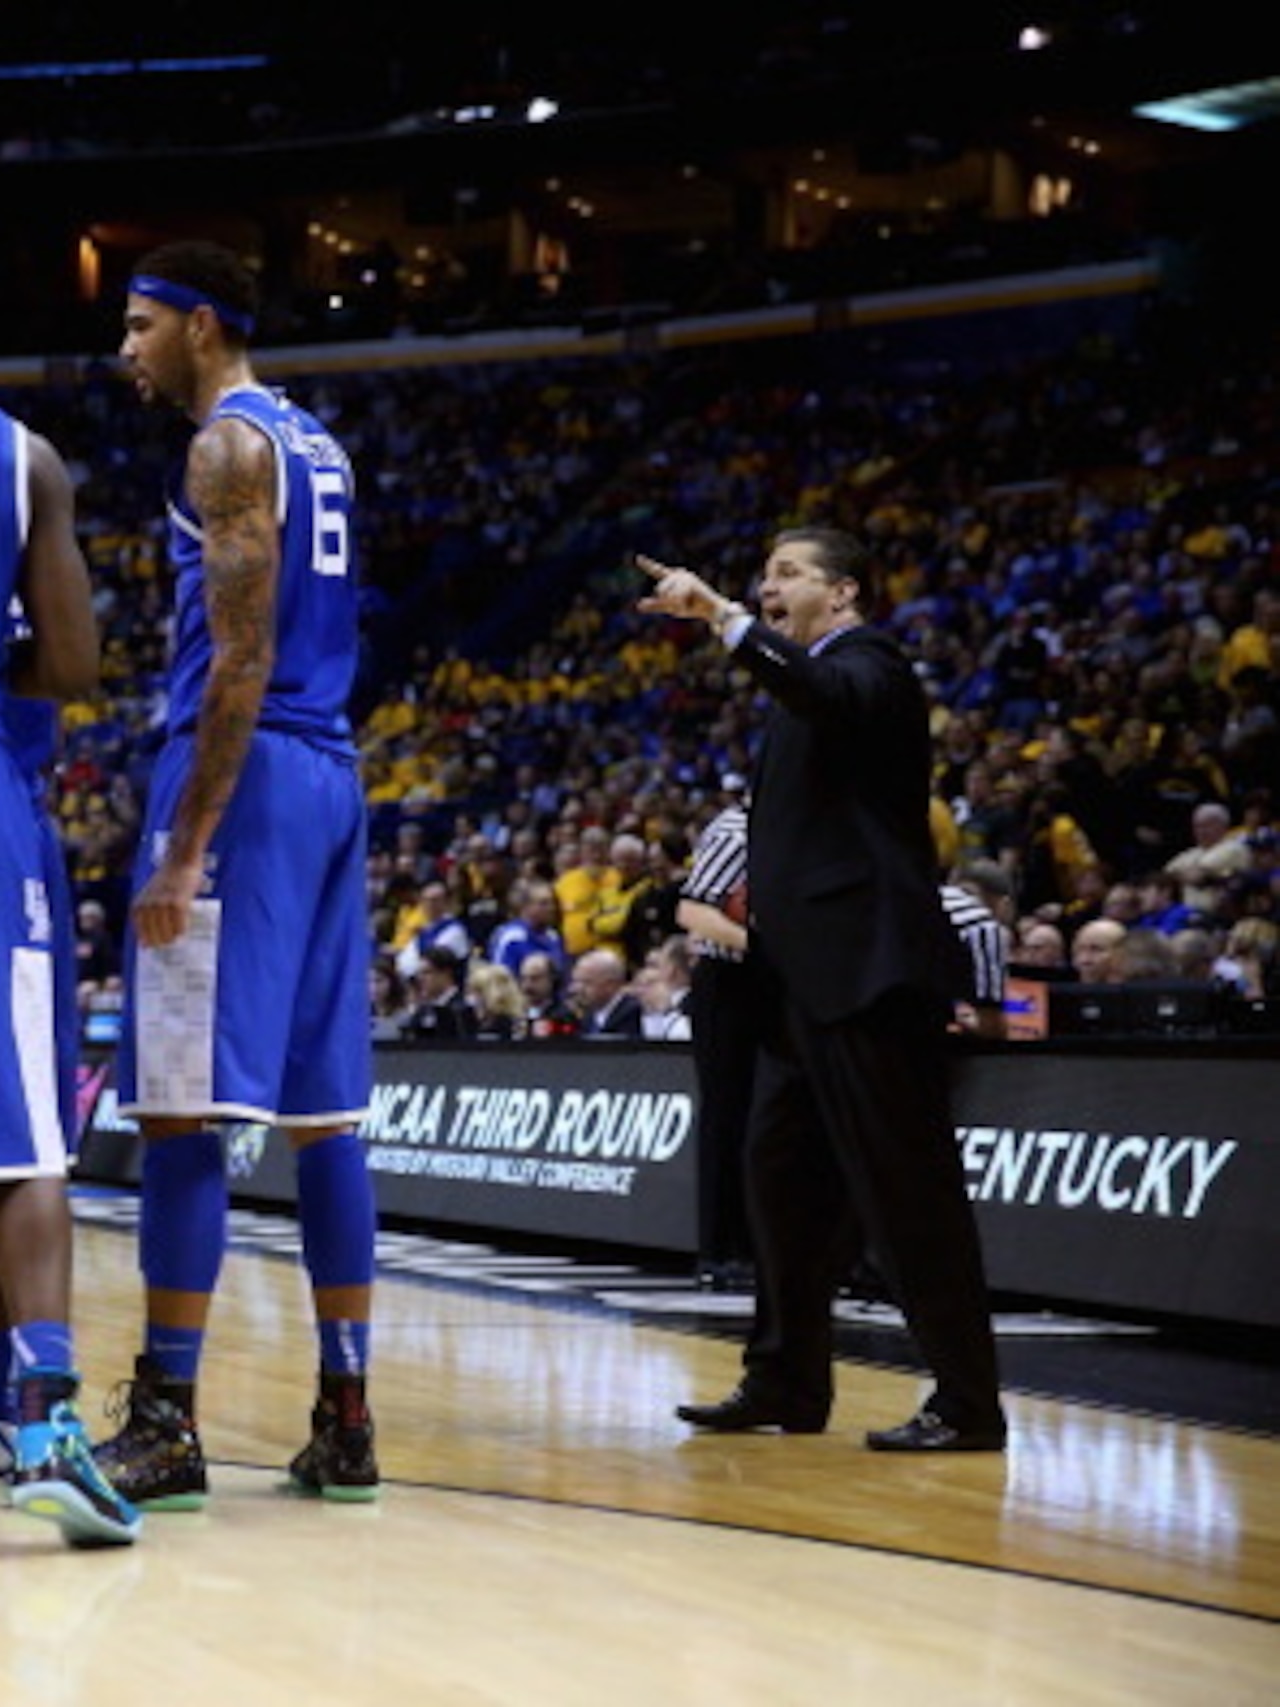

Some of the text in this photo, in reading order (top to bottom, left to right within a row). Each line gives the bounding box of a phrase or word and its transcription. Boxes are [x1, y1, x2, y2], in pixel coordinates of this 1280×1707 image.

[358, 1083, 693, 1162] NCAA THIRD ROUND
[954, 1126, 1237, 1219] ENTUCKY
